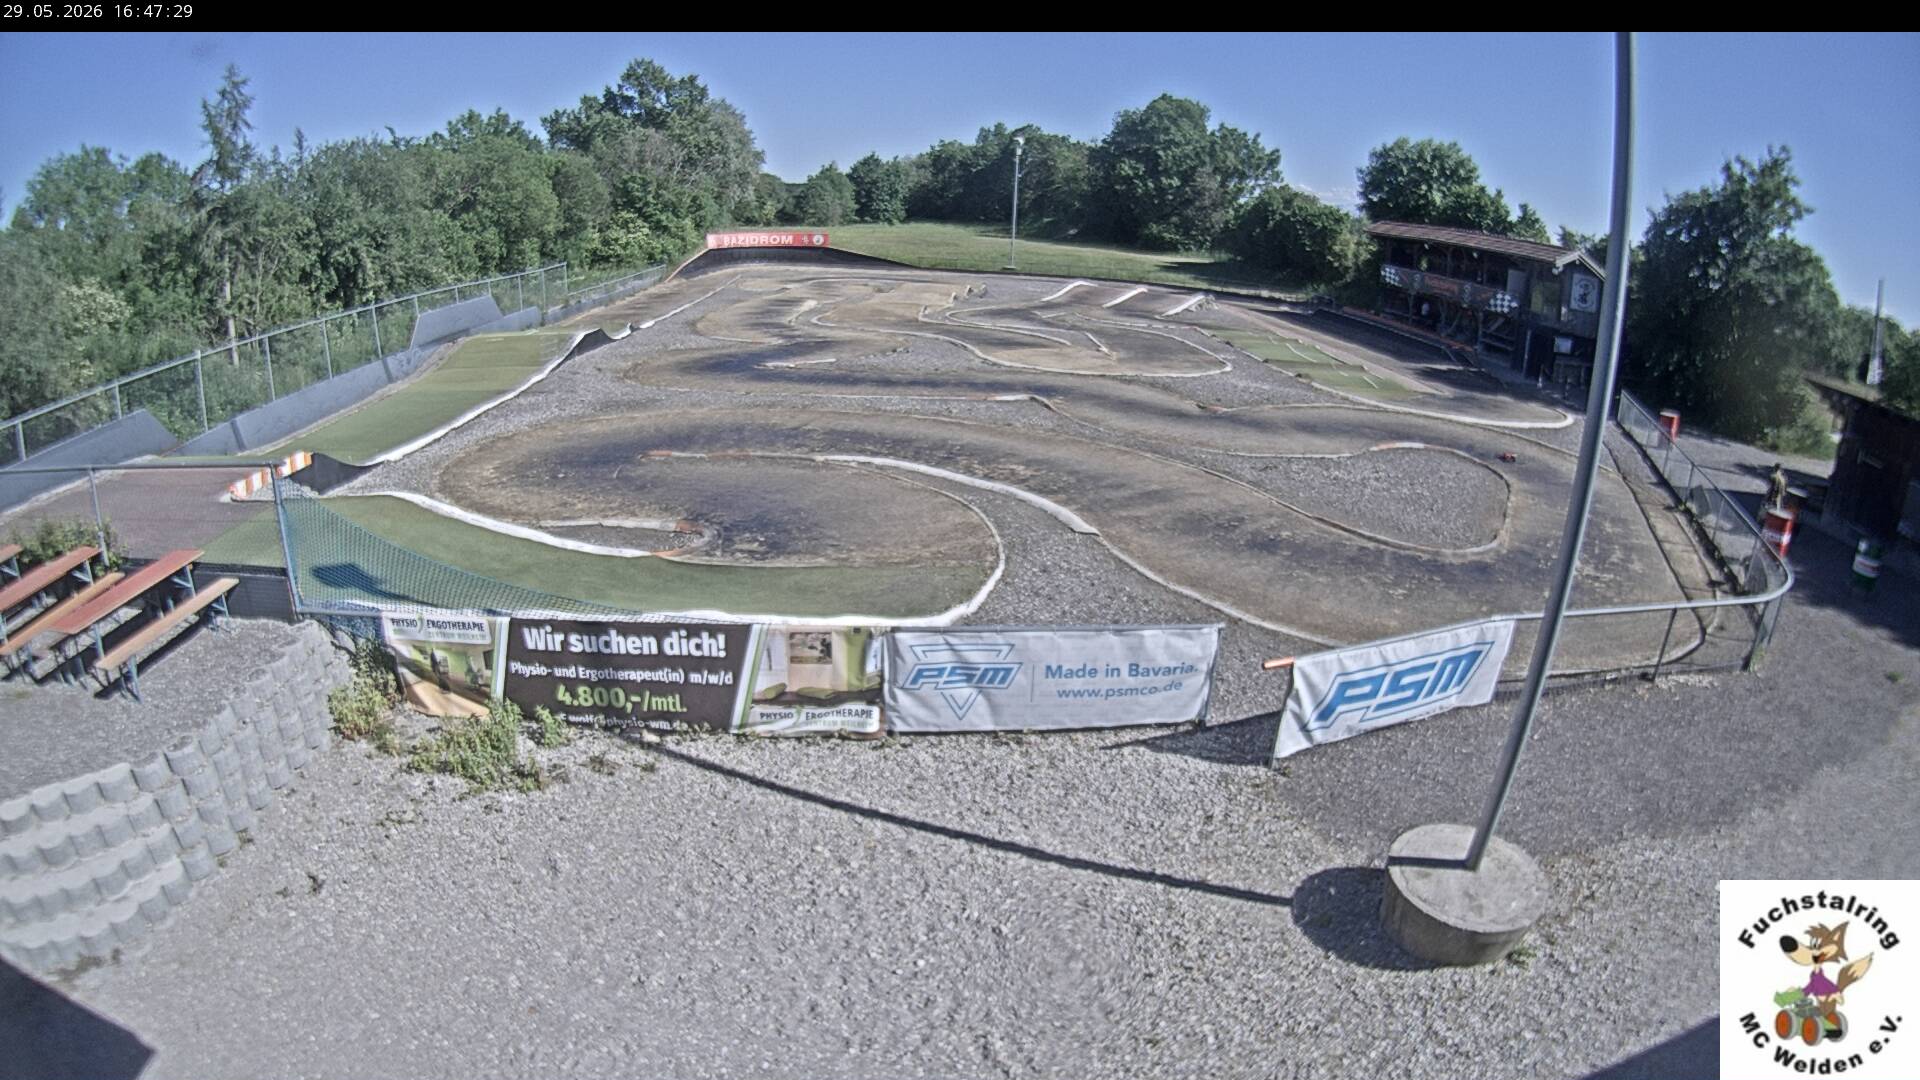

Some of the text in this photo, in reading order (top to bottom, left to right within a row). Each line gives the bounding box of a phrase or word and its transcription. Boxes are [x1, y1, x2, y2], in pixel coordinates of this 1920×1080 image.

[723, 234, 794, 246] BAZIDROM
[391, 618, 485, 632] PHYSIO ERGOTHERAPIE
[521, 625, 728, 658] Wir suchen dich!
[510, 661, 734, 686] Physio- und Ergotherapeut(in) m/w/d
[908, 665, 1015, 686] PSM
[1045, 661, 1199, 680] Made in Bavaria.
[1057, 680, 1183, 700] www.psmco.de
[1313, 649, 1485, 722] PSM
[760, 708, 873, 721] PHYSIO ERGOTHERAPIE
